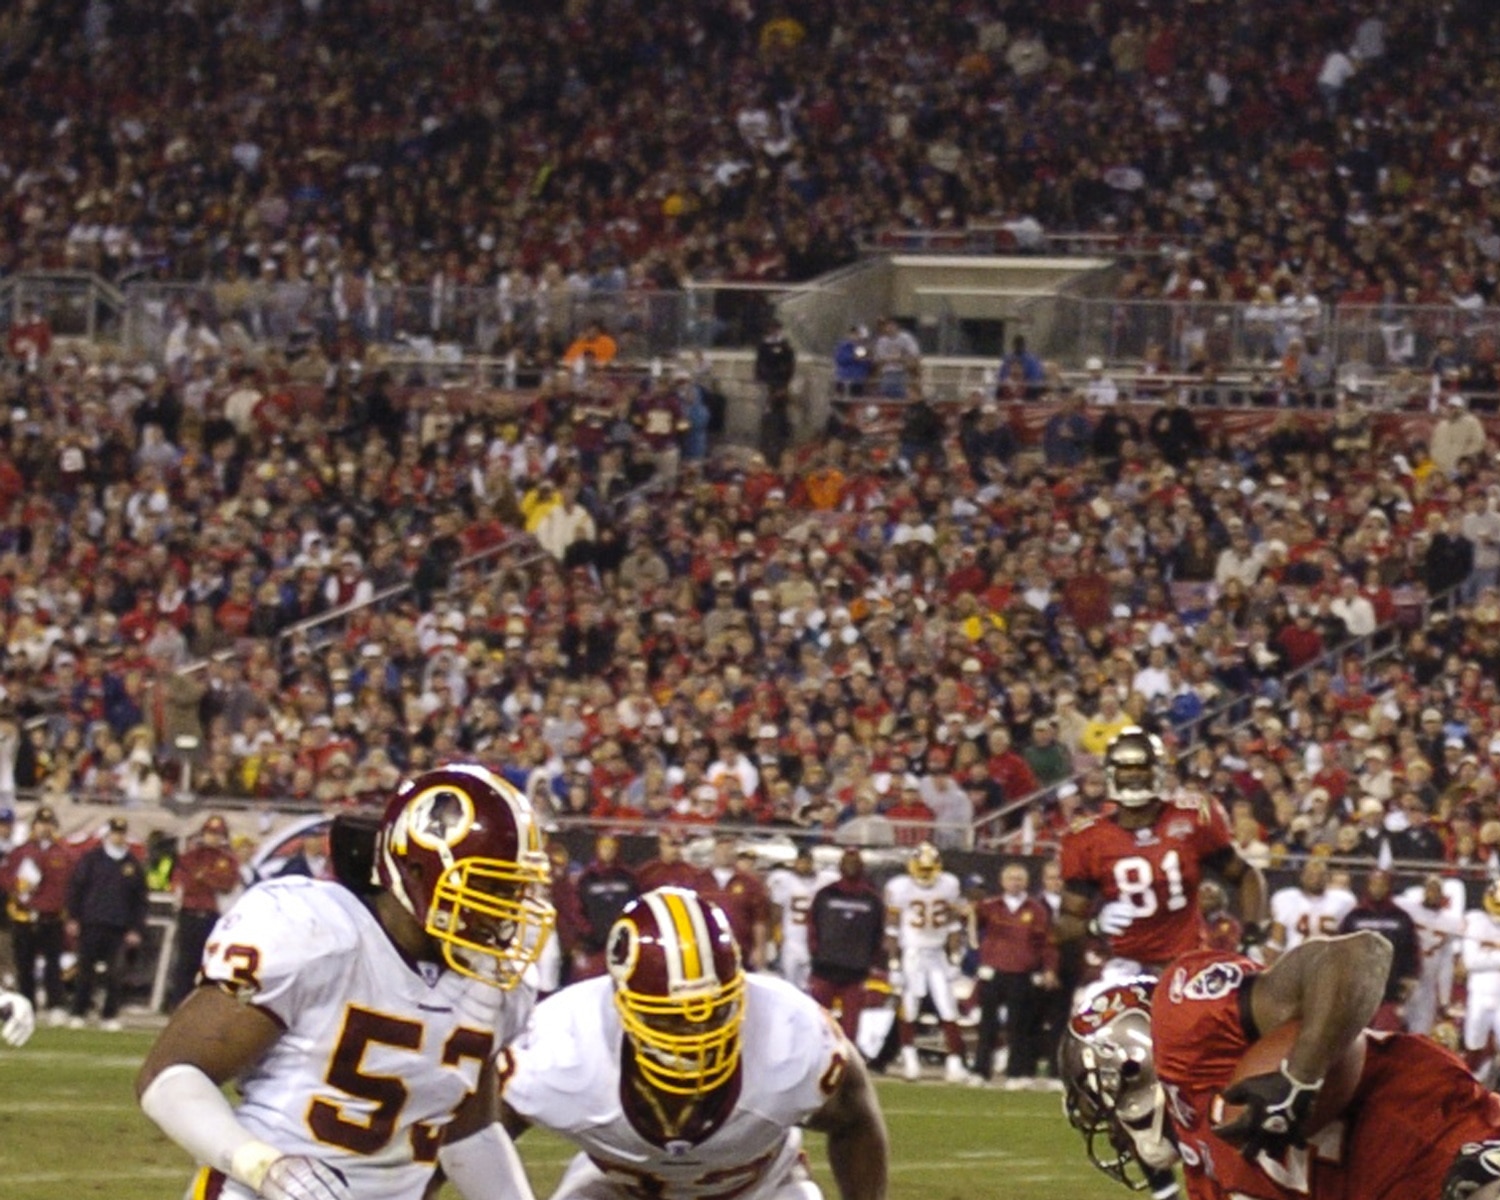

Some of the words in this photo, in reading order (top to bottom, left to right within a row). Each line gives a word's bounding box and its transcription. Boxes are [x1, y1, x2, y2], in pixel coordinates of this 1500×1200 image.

[1112, 849, 1188, 919] 81
[206, 941, 263, 992] 3
[306, 1001, 497, 1168] 53
